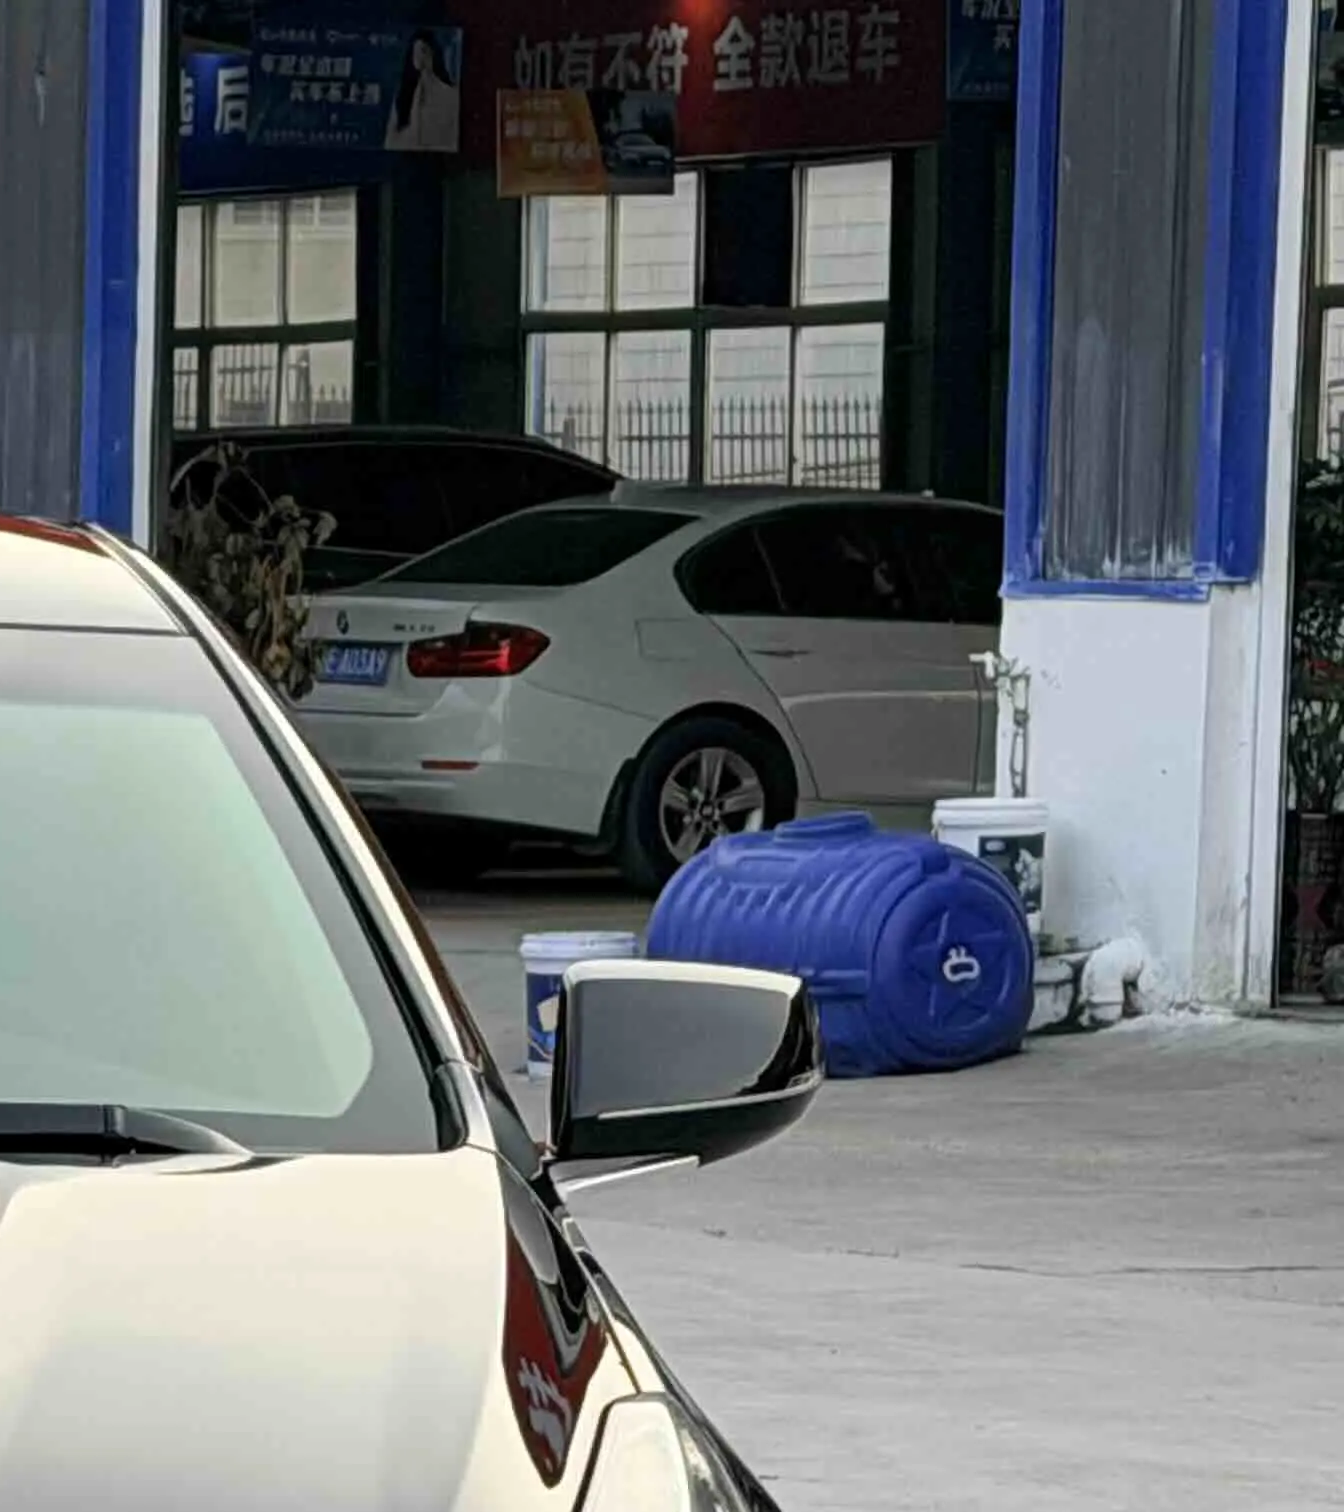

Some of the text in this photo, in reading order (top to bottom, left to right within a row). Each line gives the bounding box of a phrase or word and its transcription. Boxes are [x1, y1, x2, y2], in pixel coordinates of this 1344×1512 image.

[514, 3, 902, 94] 如有不符 全款退车
